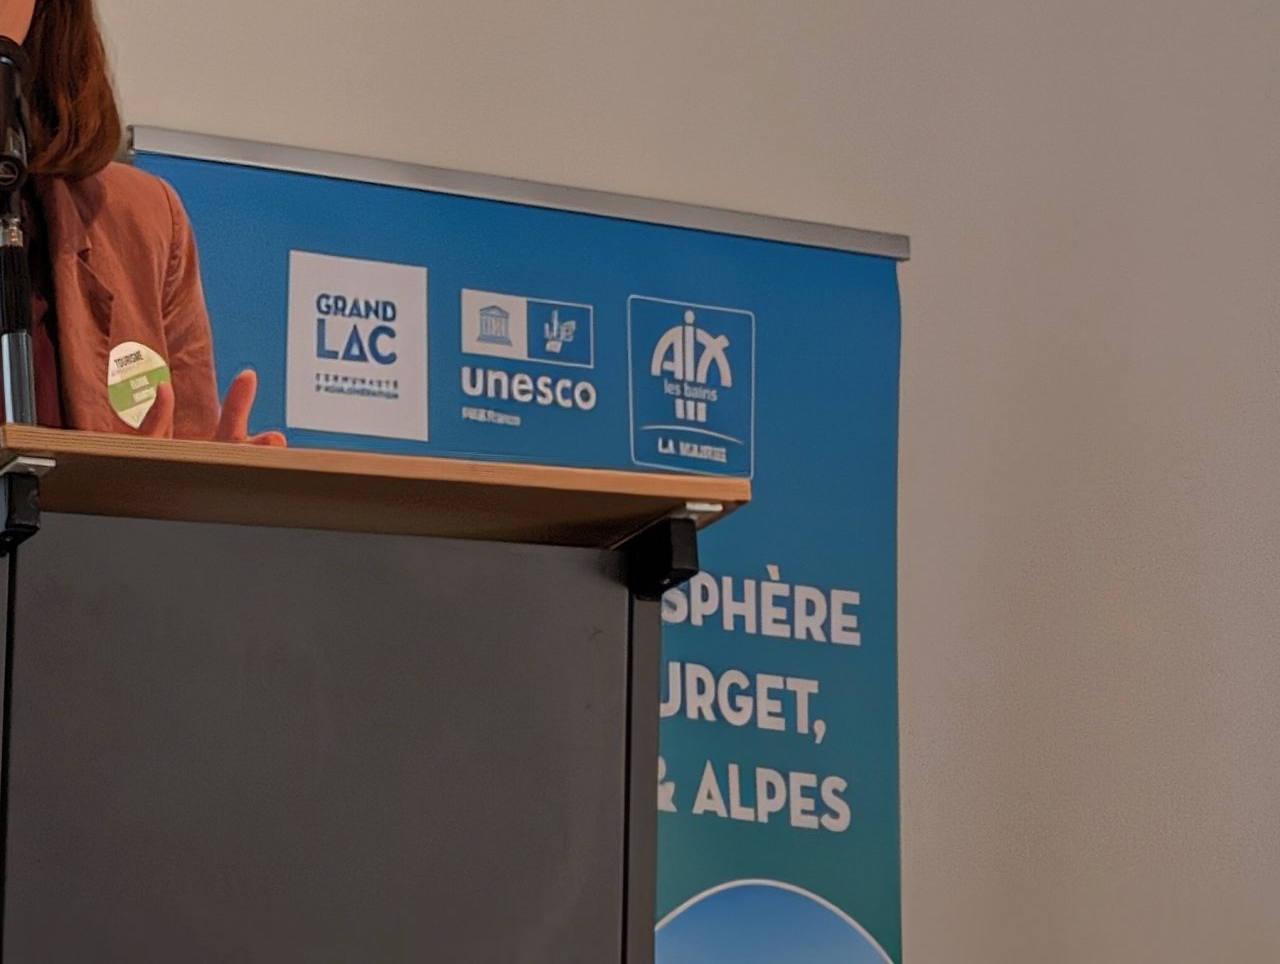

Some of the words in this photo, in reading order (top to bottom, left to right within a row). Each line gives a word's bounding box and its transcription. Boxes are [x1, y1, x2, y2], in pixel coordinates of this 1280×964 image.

[315, 293, 397, 323] GRAND
[315, 318, 398, 366] LAC
[651, 310, 733, 388] AIX
[461, 366, 597, 411] unesco
[663, 378, 681, 396] les
[683, 381, 718, 402] bains
[657, 436, 676, 454] LA
[691, 760, 852, 833] ALPES
